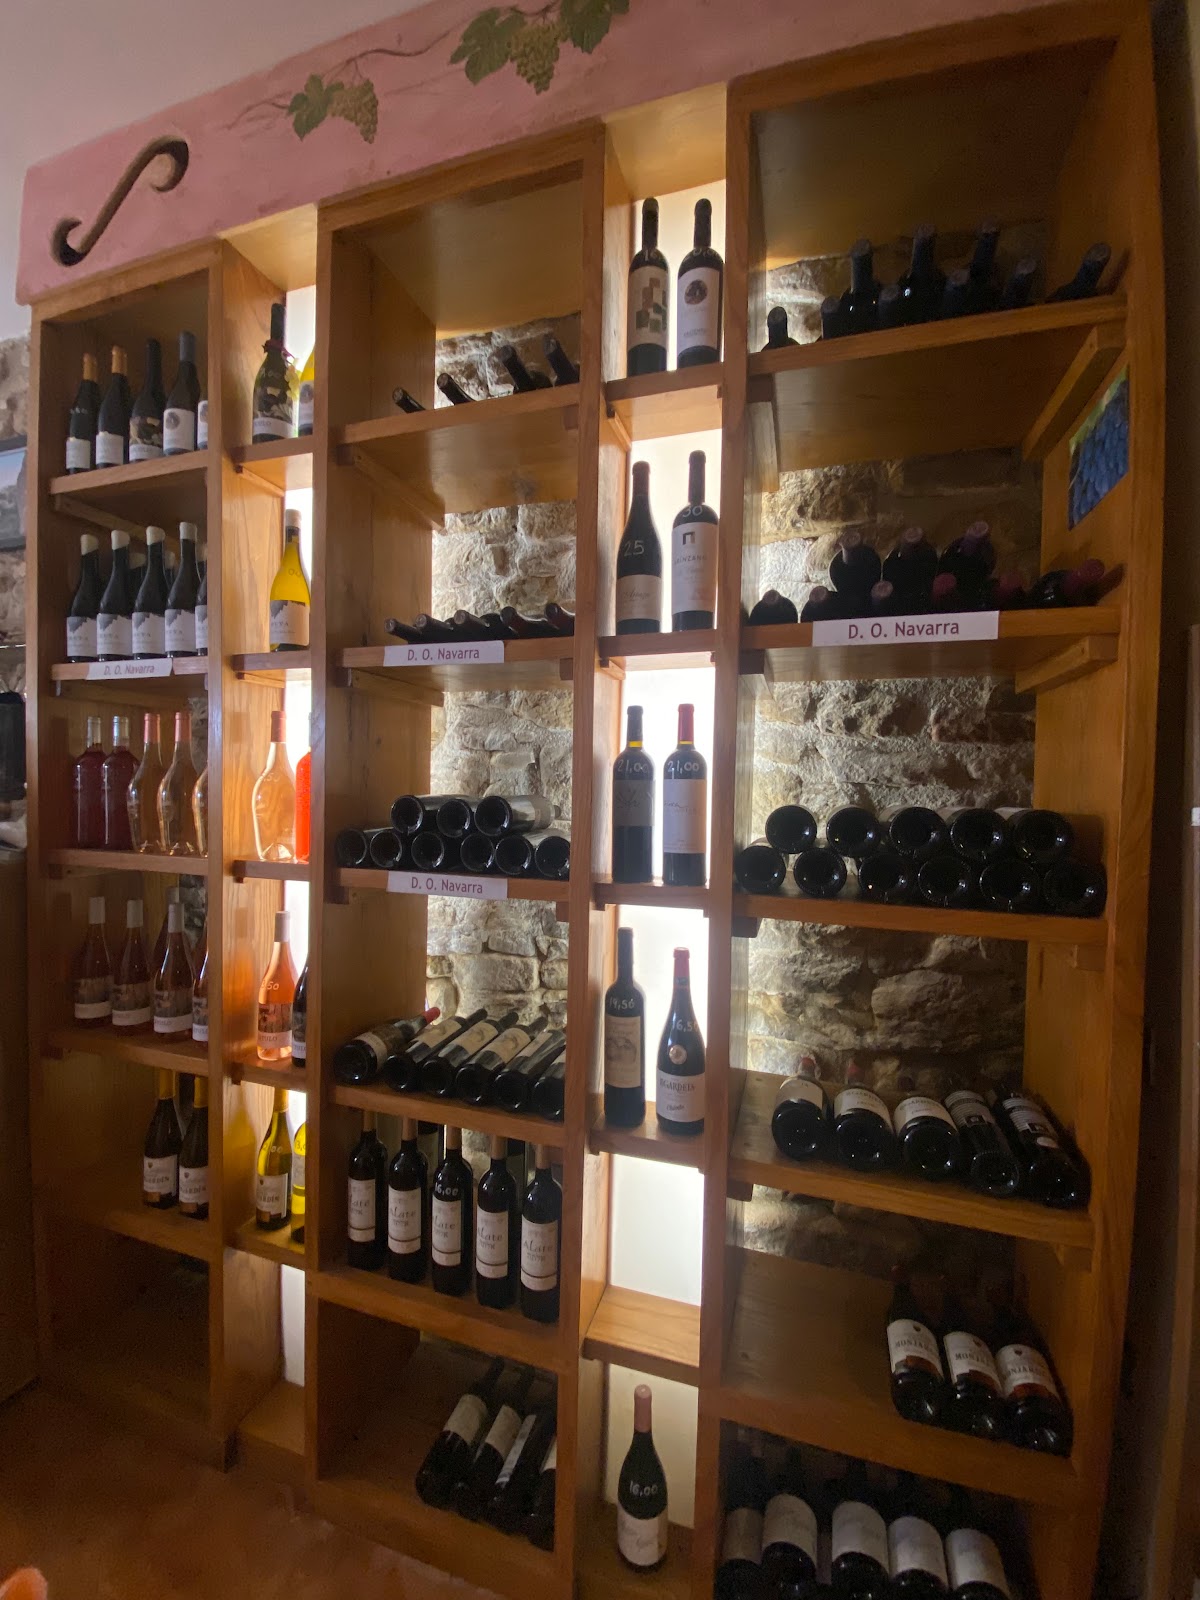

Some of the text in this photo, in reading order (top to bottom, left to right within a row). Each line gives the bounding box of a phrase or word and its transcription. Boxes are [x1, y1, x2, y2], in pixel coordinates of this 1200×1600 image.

[682, 504, 703, 518] 30
[623, 539, 645, 557] 25
[848, 621, 960, 640] D. O. Navarra
[407, 648, 480, 661] D. O. Navarra
[104, 663, 155, 676] D. O. Navarra
[617, 758, 650, 774] 21,00
[667, 760, 700, 774] 21,00
[411, 876, 483, 894] D. O. Navarra
[629, 1479, 659, 1497] 16,00
